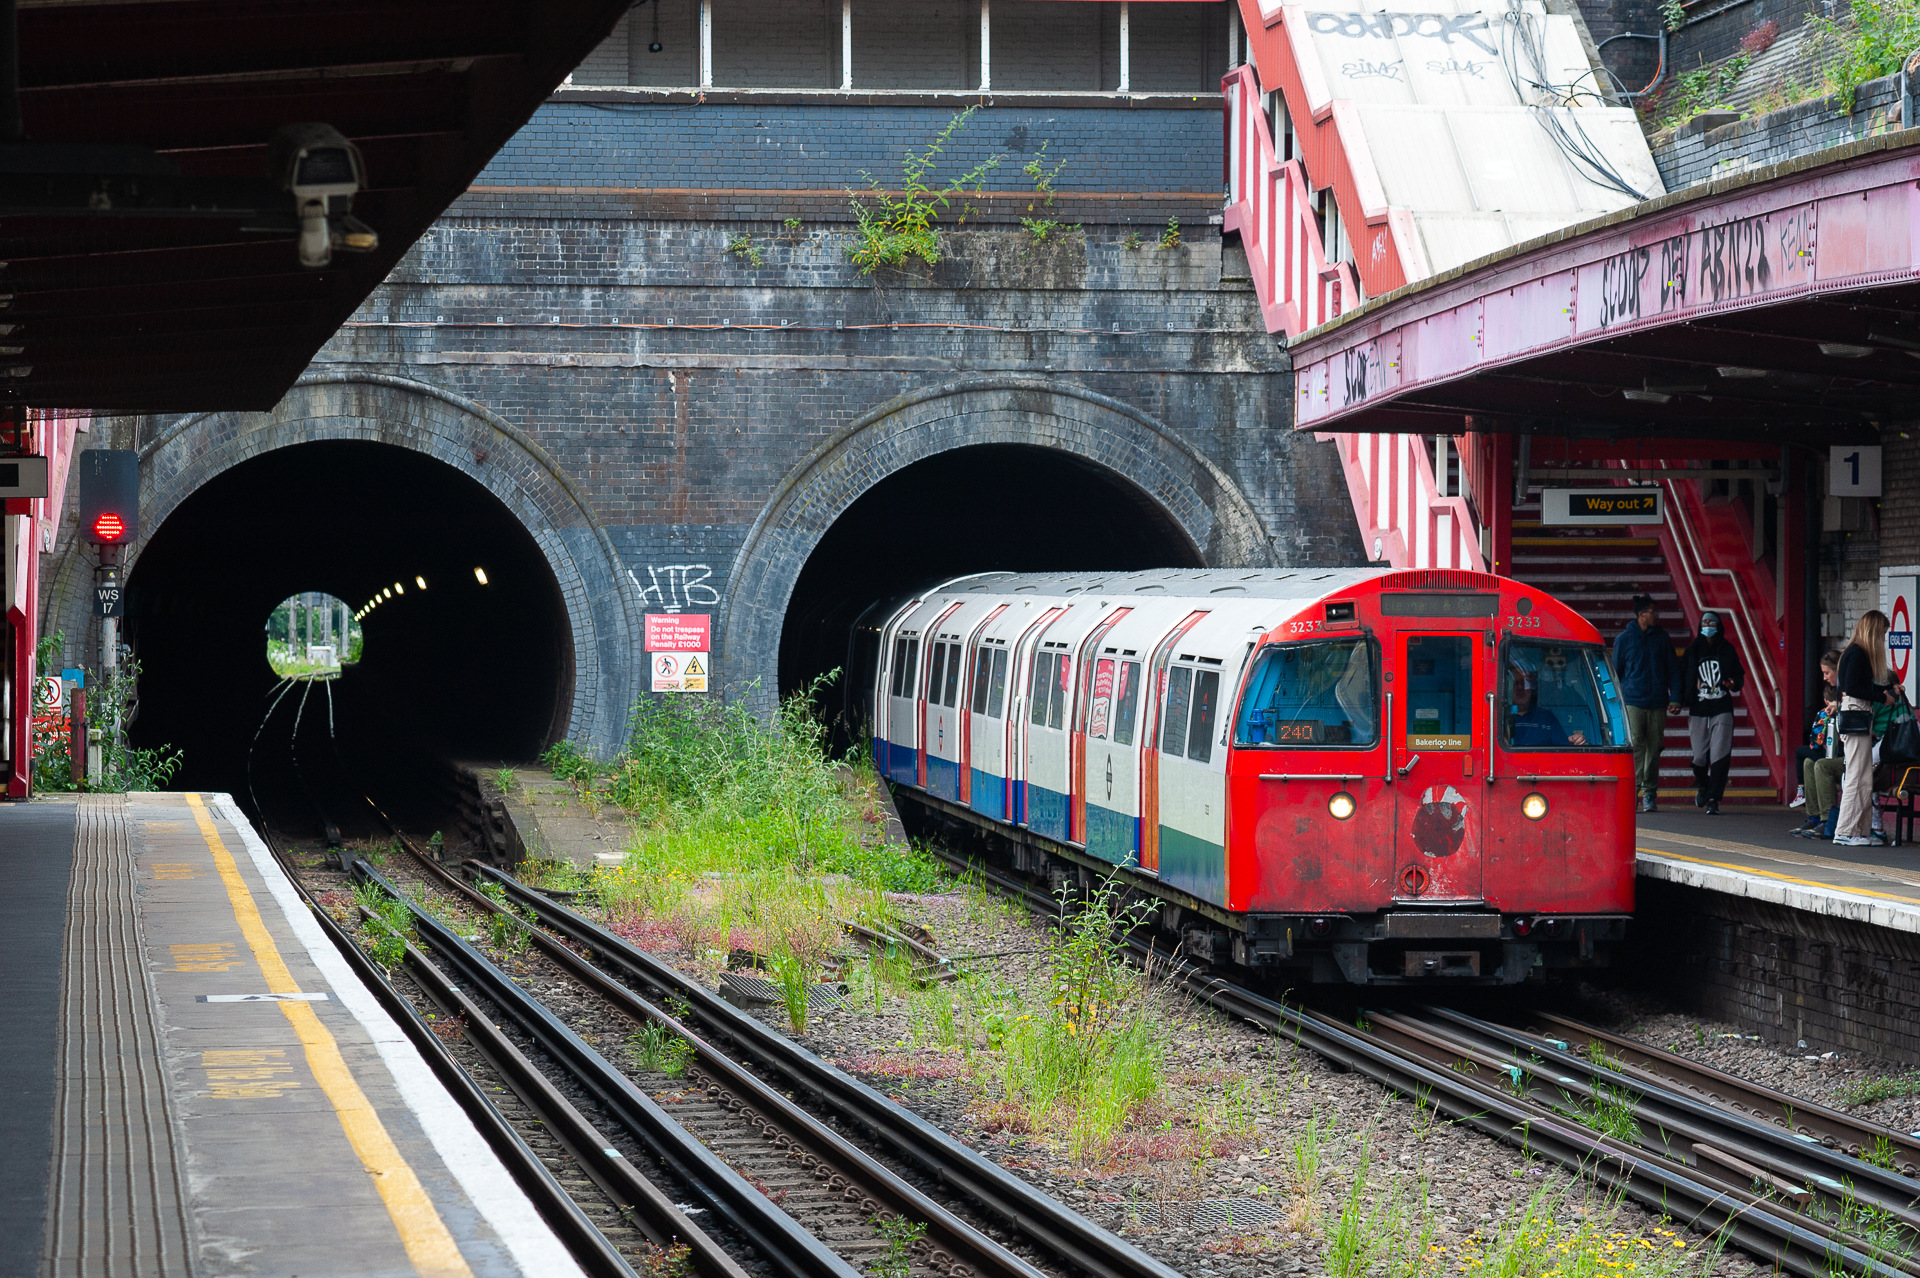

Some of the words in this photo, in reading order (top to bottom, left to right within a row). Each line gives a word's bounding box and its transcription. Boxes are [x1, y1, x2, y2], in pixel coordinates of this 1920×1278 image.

[1843, 452, 1859, 485] 1
[1586, 497, 1614, 512] Way
[1616, 499, 1640, 509] out
[98, 589, 119, 600] WS
[103, 603, 113, 613] 17
[650, 616, 680, 624] Warning
[1507, 616, 1541, 628] 3233
[1290, 621, 1323, 633] 3233
[650, 641, 677, 649] Penalty
[1567, 715, 1573, 723] 2
[1281, 725, 1312, 740] 240
[1415, 738, 1447, 746] Bakerloo
[1448, 738, 1462, 746] line
